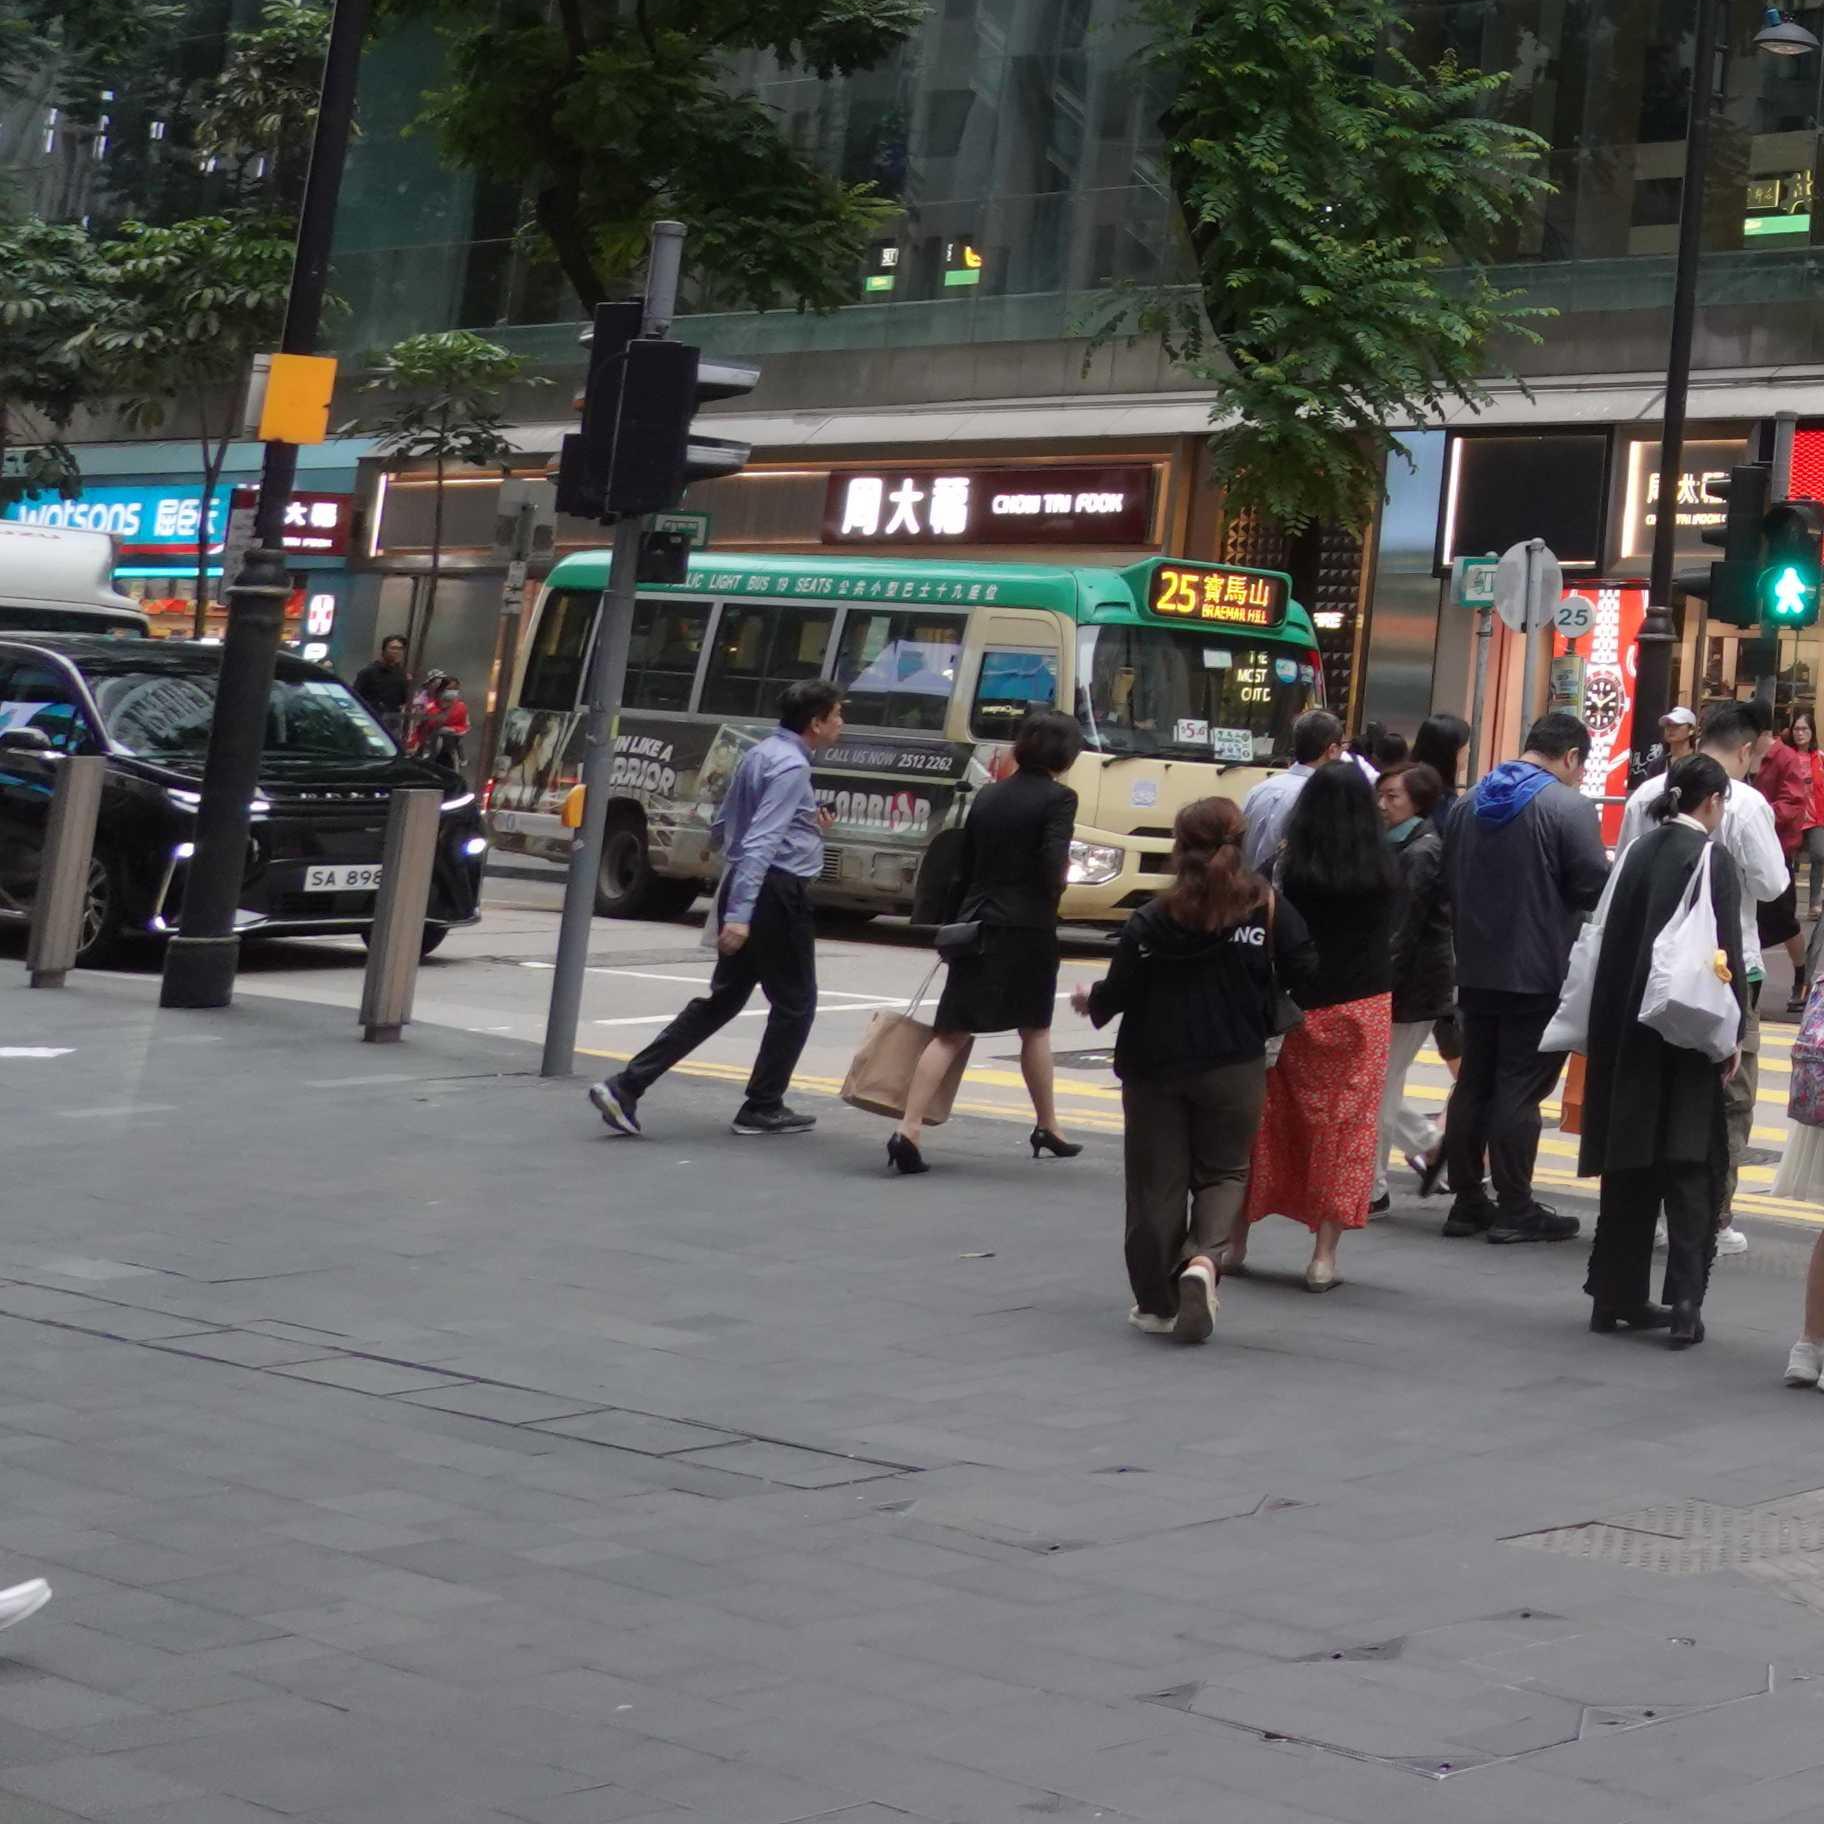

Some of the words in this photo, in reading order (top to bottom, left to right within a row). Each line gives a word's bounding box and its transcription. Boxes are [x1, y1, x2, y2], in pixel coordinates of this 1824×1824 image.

[841, 477, 970, 535] 周大福
[1075, 493, 1123, 513] FOOK
[709, 574, 741, 590] LIGHT
[748, 576, 768, 591] BUS
[796, 577, 833, 594] SEATS
[1157, 570, 1198, 612] 25
[1559, 608, 1589, 626] 25
[632, 736, 662, 758] LIKE
[662, 743, 674, 762] A
[824, 748, 849, 761] CALL
[853, 750, 866, 763] US
[867, 751, 896, 765] NOW
[898, 754, 926, 769] 2512
[927, 756, 953, 772] 2262
[610, 757, 676, 796] RRIOR
[312, 871, 336, 886] SA
